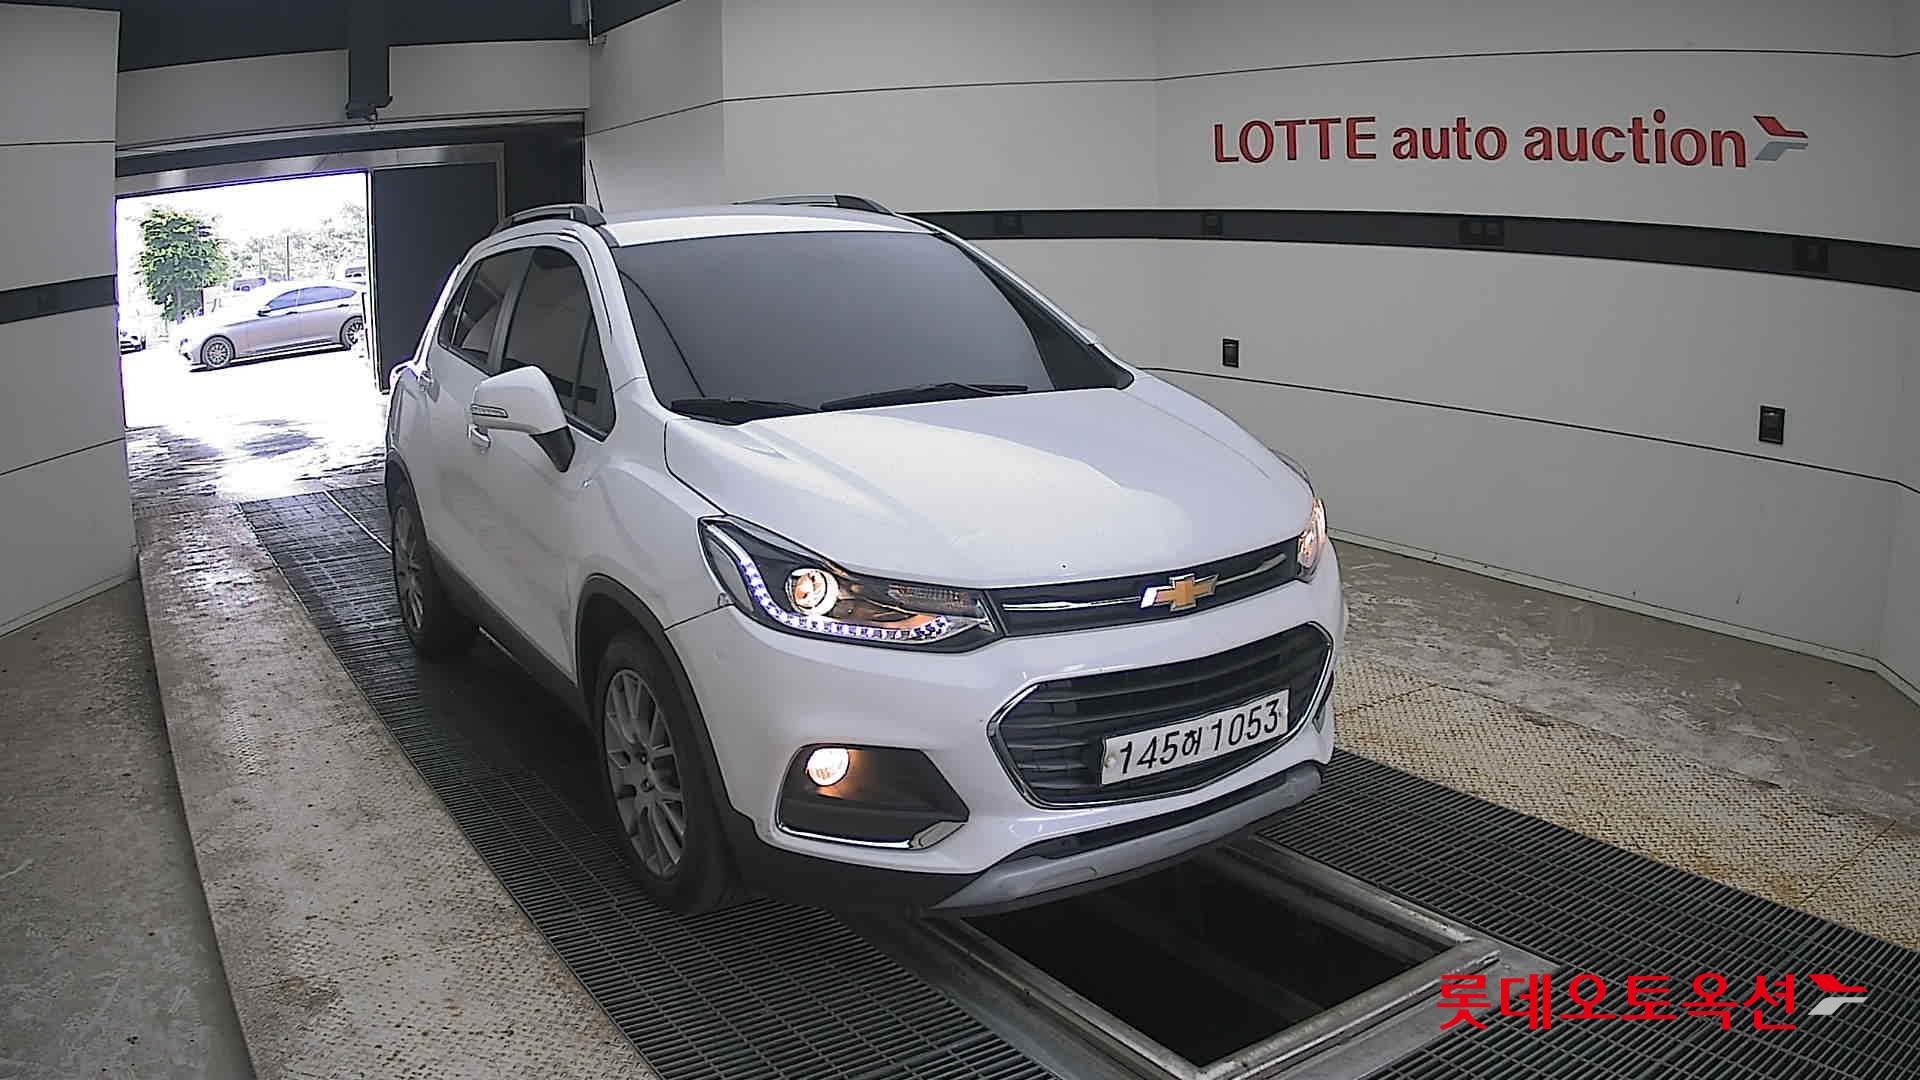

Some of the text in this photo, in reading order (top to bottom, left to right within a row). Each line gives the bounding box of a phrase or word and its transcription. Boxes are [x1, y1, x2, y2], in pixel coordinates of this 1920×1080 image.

[1213, 108, 1747, 168] LOTTE auto auction
[1211, 698, 1280, 750] 1053
